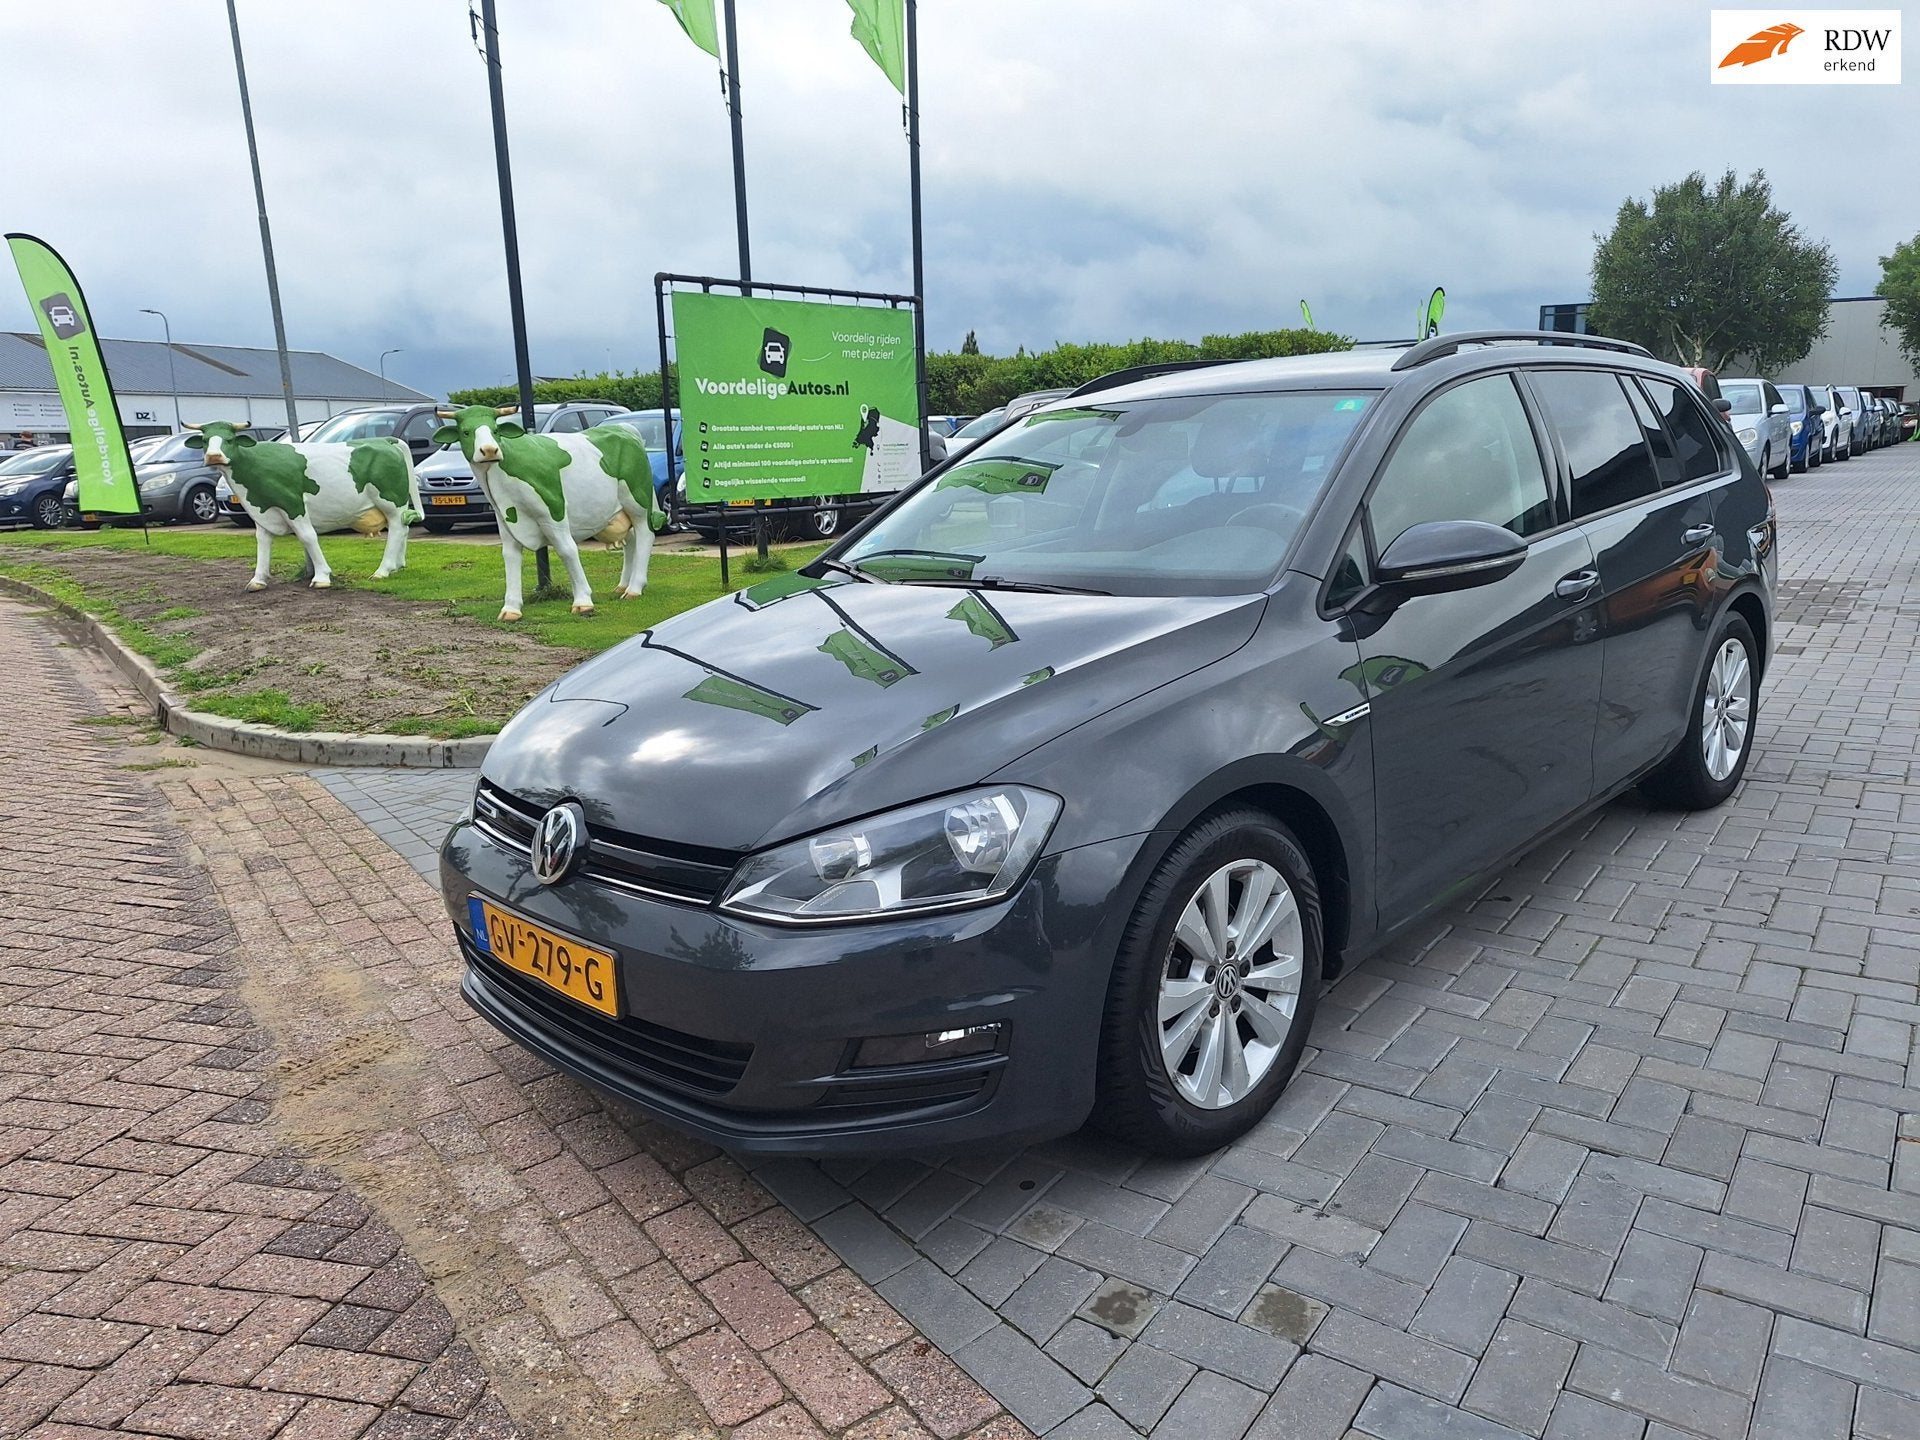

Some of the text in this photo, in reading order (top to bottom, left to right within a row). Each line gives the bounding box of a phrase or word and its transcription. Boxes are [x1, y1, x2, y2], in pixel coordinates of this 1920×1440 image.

[832, 331, 901, 347] Voordelig rijden
[842, 348, 894, 361] met plezier!
[694, 377, 849, 400] VoordeligeAutos.nl
[476, 929, 488, 941] NL
[490, 914, 603, 1001] GV-279-G
